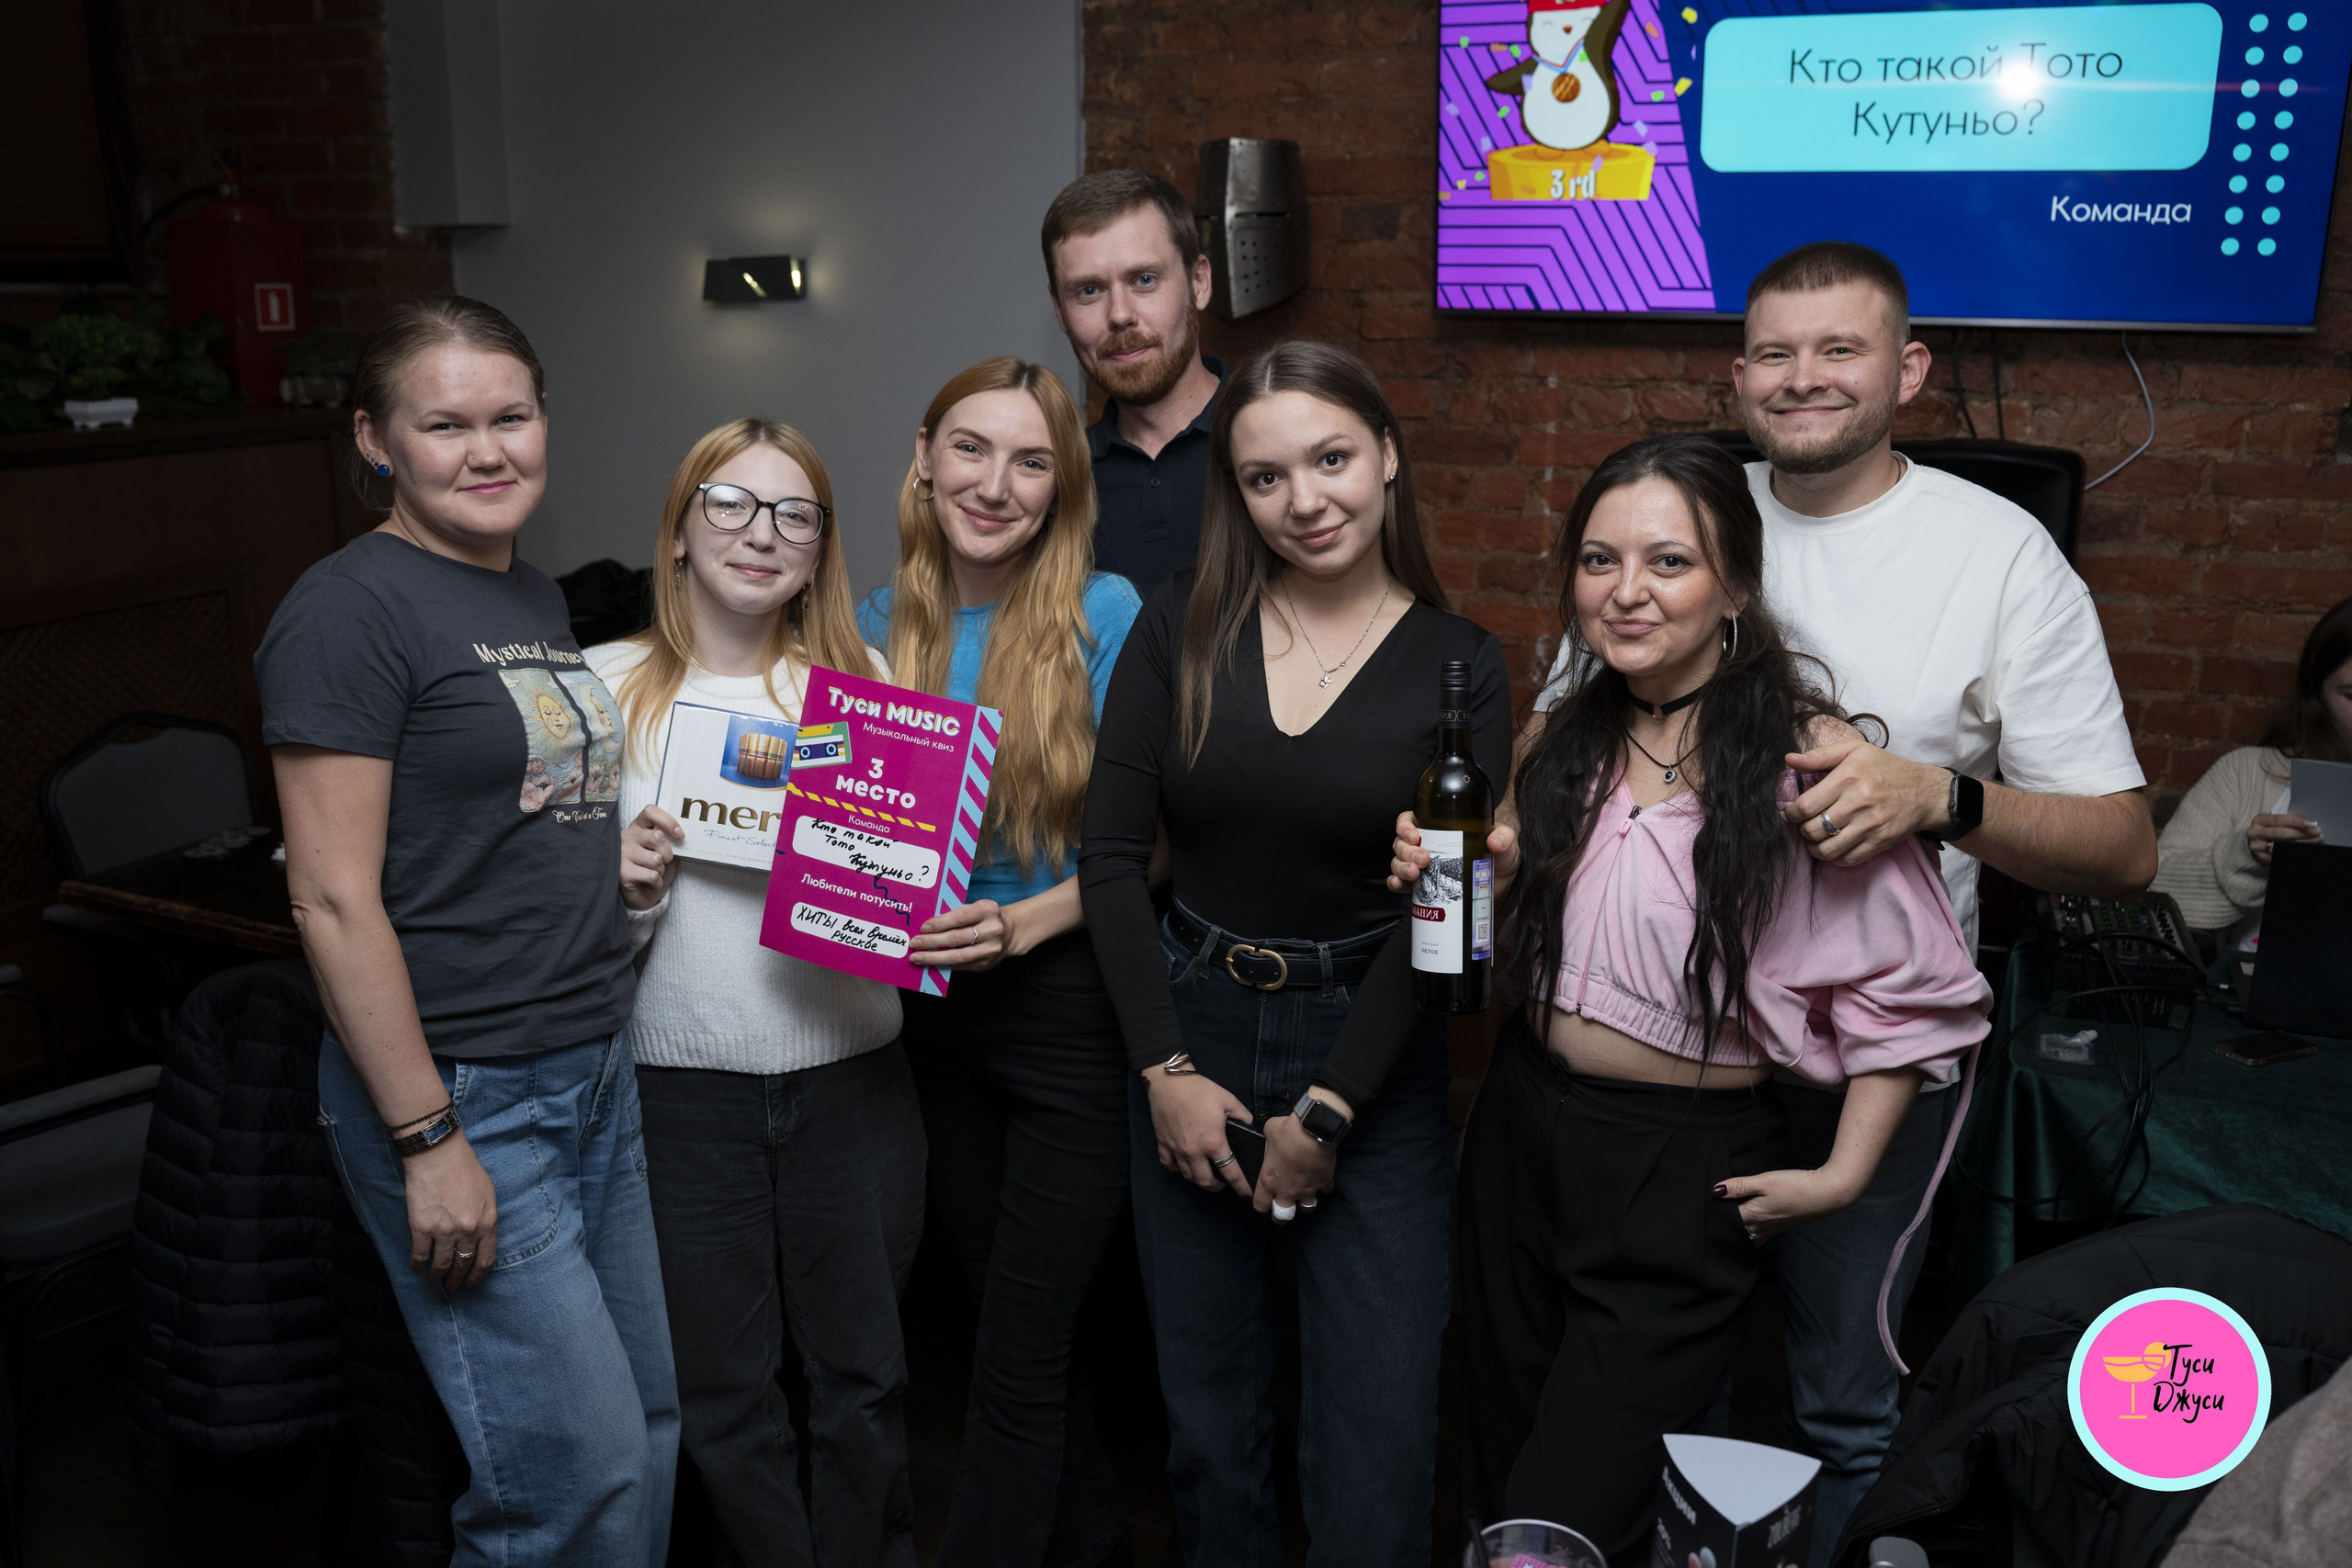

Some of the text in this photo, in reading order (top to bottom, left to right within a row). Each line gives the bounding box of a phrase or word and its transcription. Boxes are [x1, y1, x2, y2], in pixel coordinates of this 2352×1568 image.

[1790, 42, 2123, 85] Кто такой Тото
[1852, 98, 2045, 144] Кутуньо?
[2050, 196, 2192, 225] Команда
[472, 641, 545, 667] Mystical
[828, 686, 961, 737] Туси MUSIC
[863, 722, 955, 753] Музыкальный квиз
[867, 757, 885, 779] 3
[835, 774, 916, 809] место
[680, 796, 783, 832] mer
[848, 814, 890, 833] Команда
[703, 829, 746, 841] Finest
[811, 818, 899, 849] Кто такой
[825, 834, 855, 852] Тото
[801, 873, 913, 913] Любители потусить!
[797, 906, 839, 929] ХИТЫ
[1421, 947, 1439, 955] БЕЛОЕ
